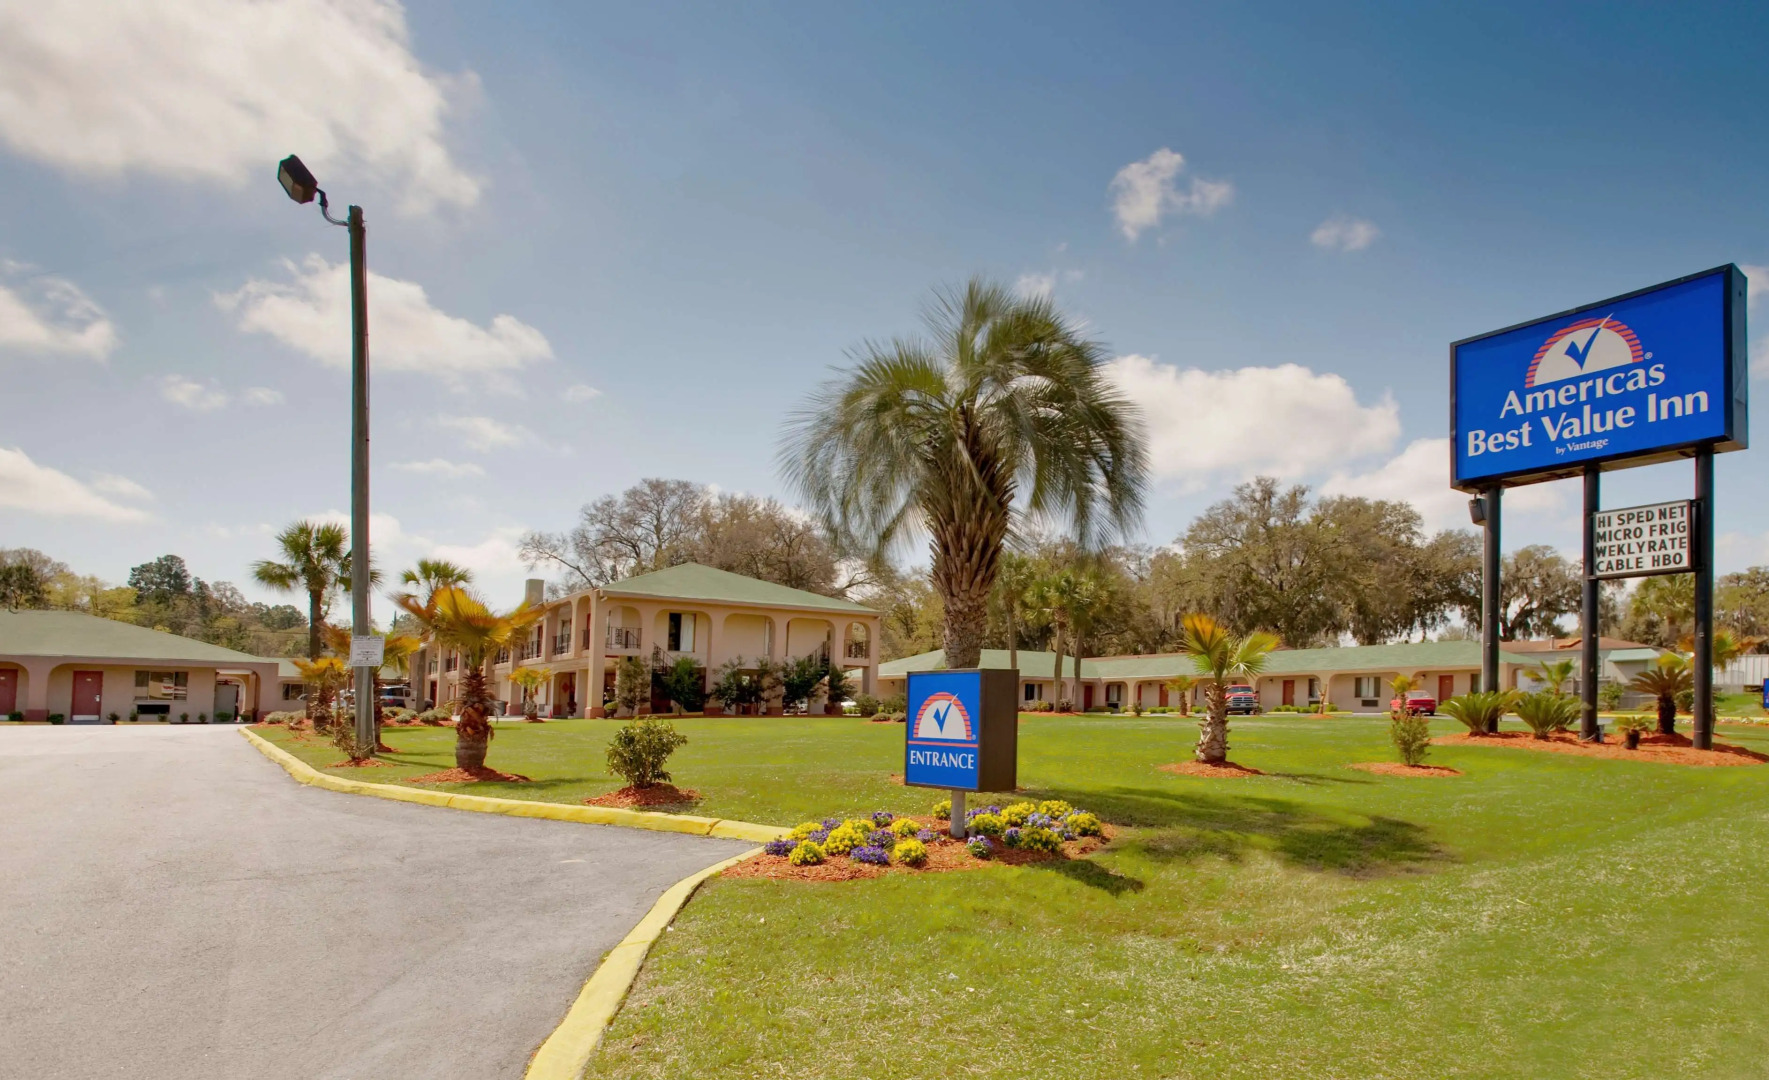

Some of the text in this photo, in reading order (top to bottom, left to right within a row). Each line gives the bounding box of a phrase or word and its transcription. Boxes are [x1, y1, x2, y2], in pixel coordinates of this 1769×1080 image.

[1500, 363, 1665, 419] Americas
[1468, 390, 1709, 457] Best Value Inn
[1555, 438, 1609, 456] by Vantage
[1598, 505, 1687, 527] HI SPED NET
[1596, 520, 1687, 543] MICRO FRIG
[1595, 552, 1683, 573] CABLE HBO
[910, 750, 974, 769] ENTRANCE
